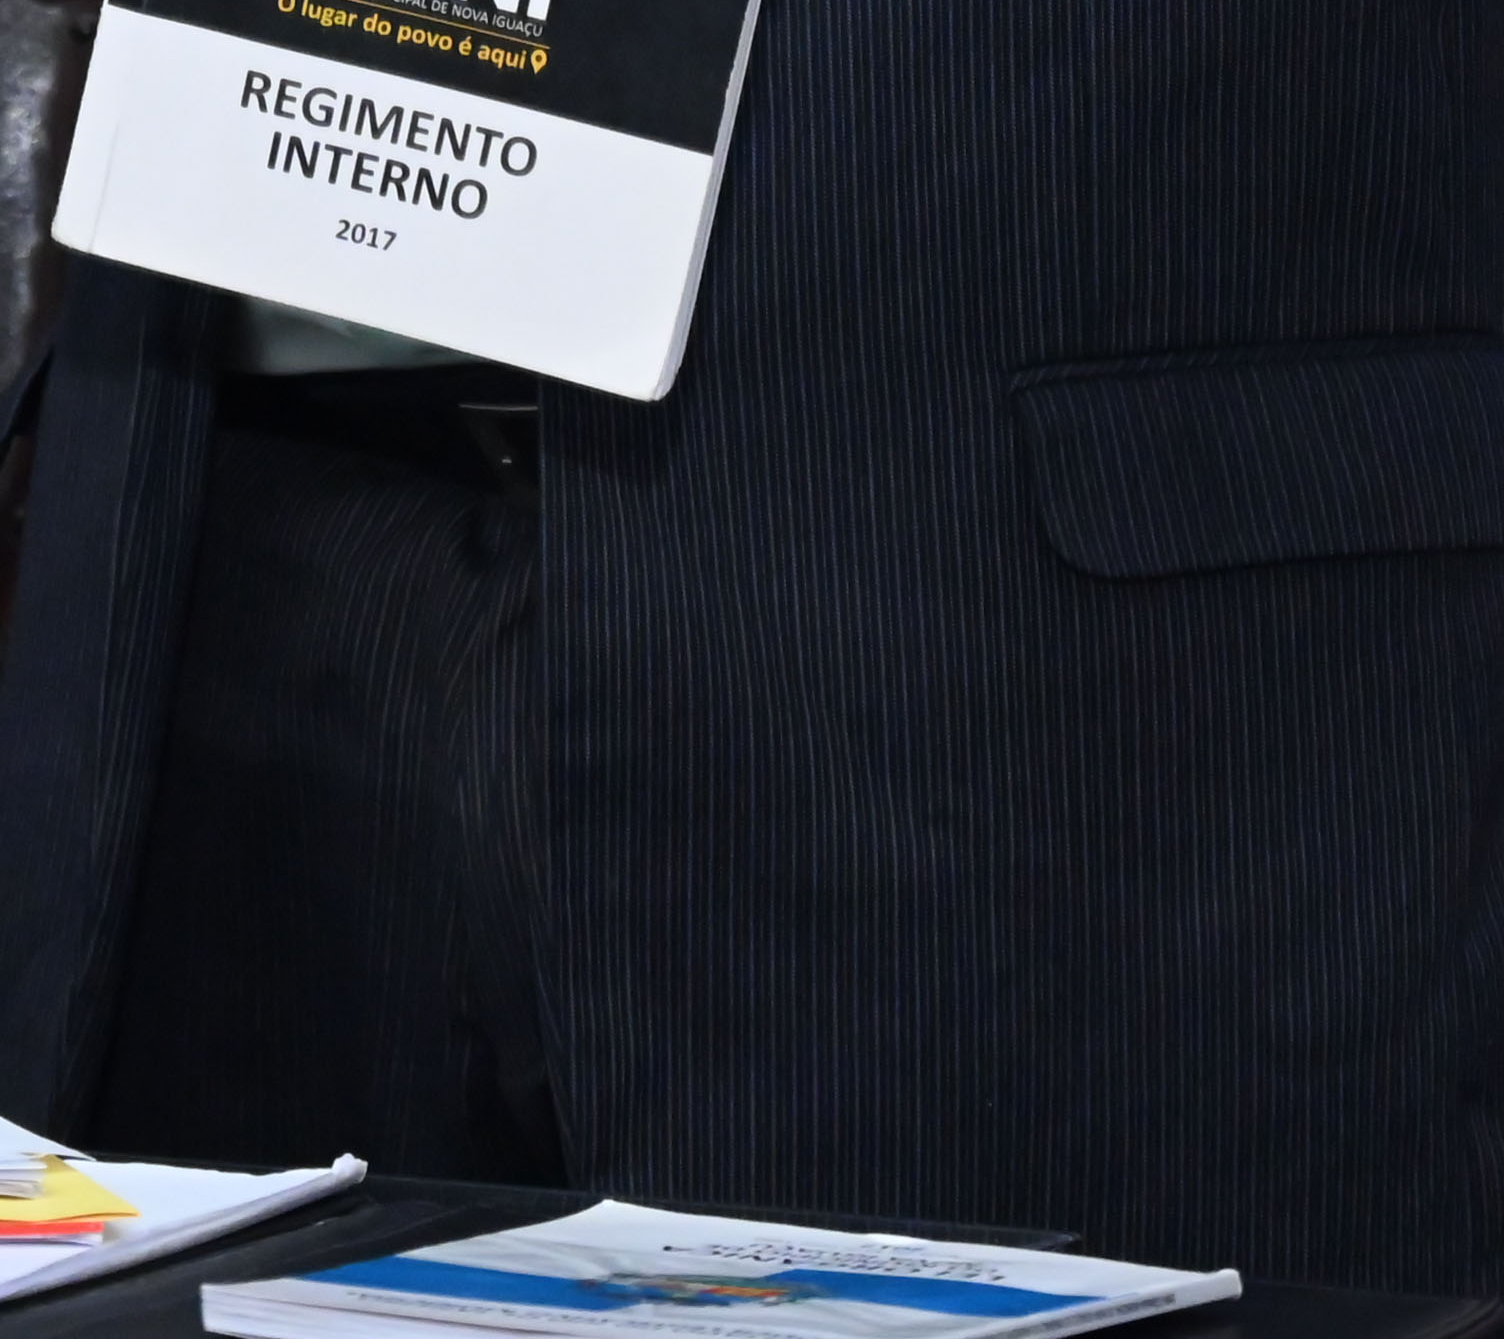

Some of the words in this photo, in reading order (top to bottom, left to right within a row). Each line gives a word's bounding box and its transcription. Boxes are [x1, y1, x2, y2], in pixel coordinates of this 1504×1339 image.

[363, 12, 391, 36] do
[397, 27, 453, 51] povo
[458, 36, 472, 56] é
[477, 44, 527, 70] aqui
[430, 0, 448, 15] DE
[451, 4, 489, 25] NOVA
[491, 14, 544, 38] IGUAÇU
[240, 69, 538, 177] REGIMENTO
[266, 130, 489, 220] INTERNO
[335, 219, 398, 251] 2017
